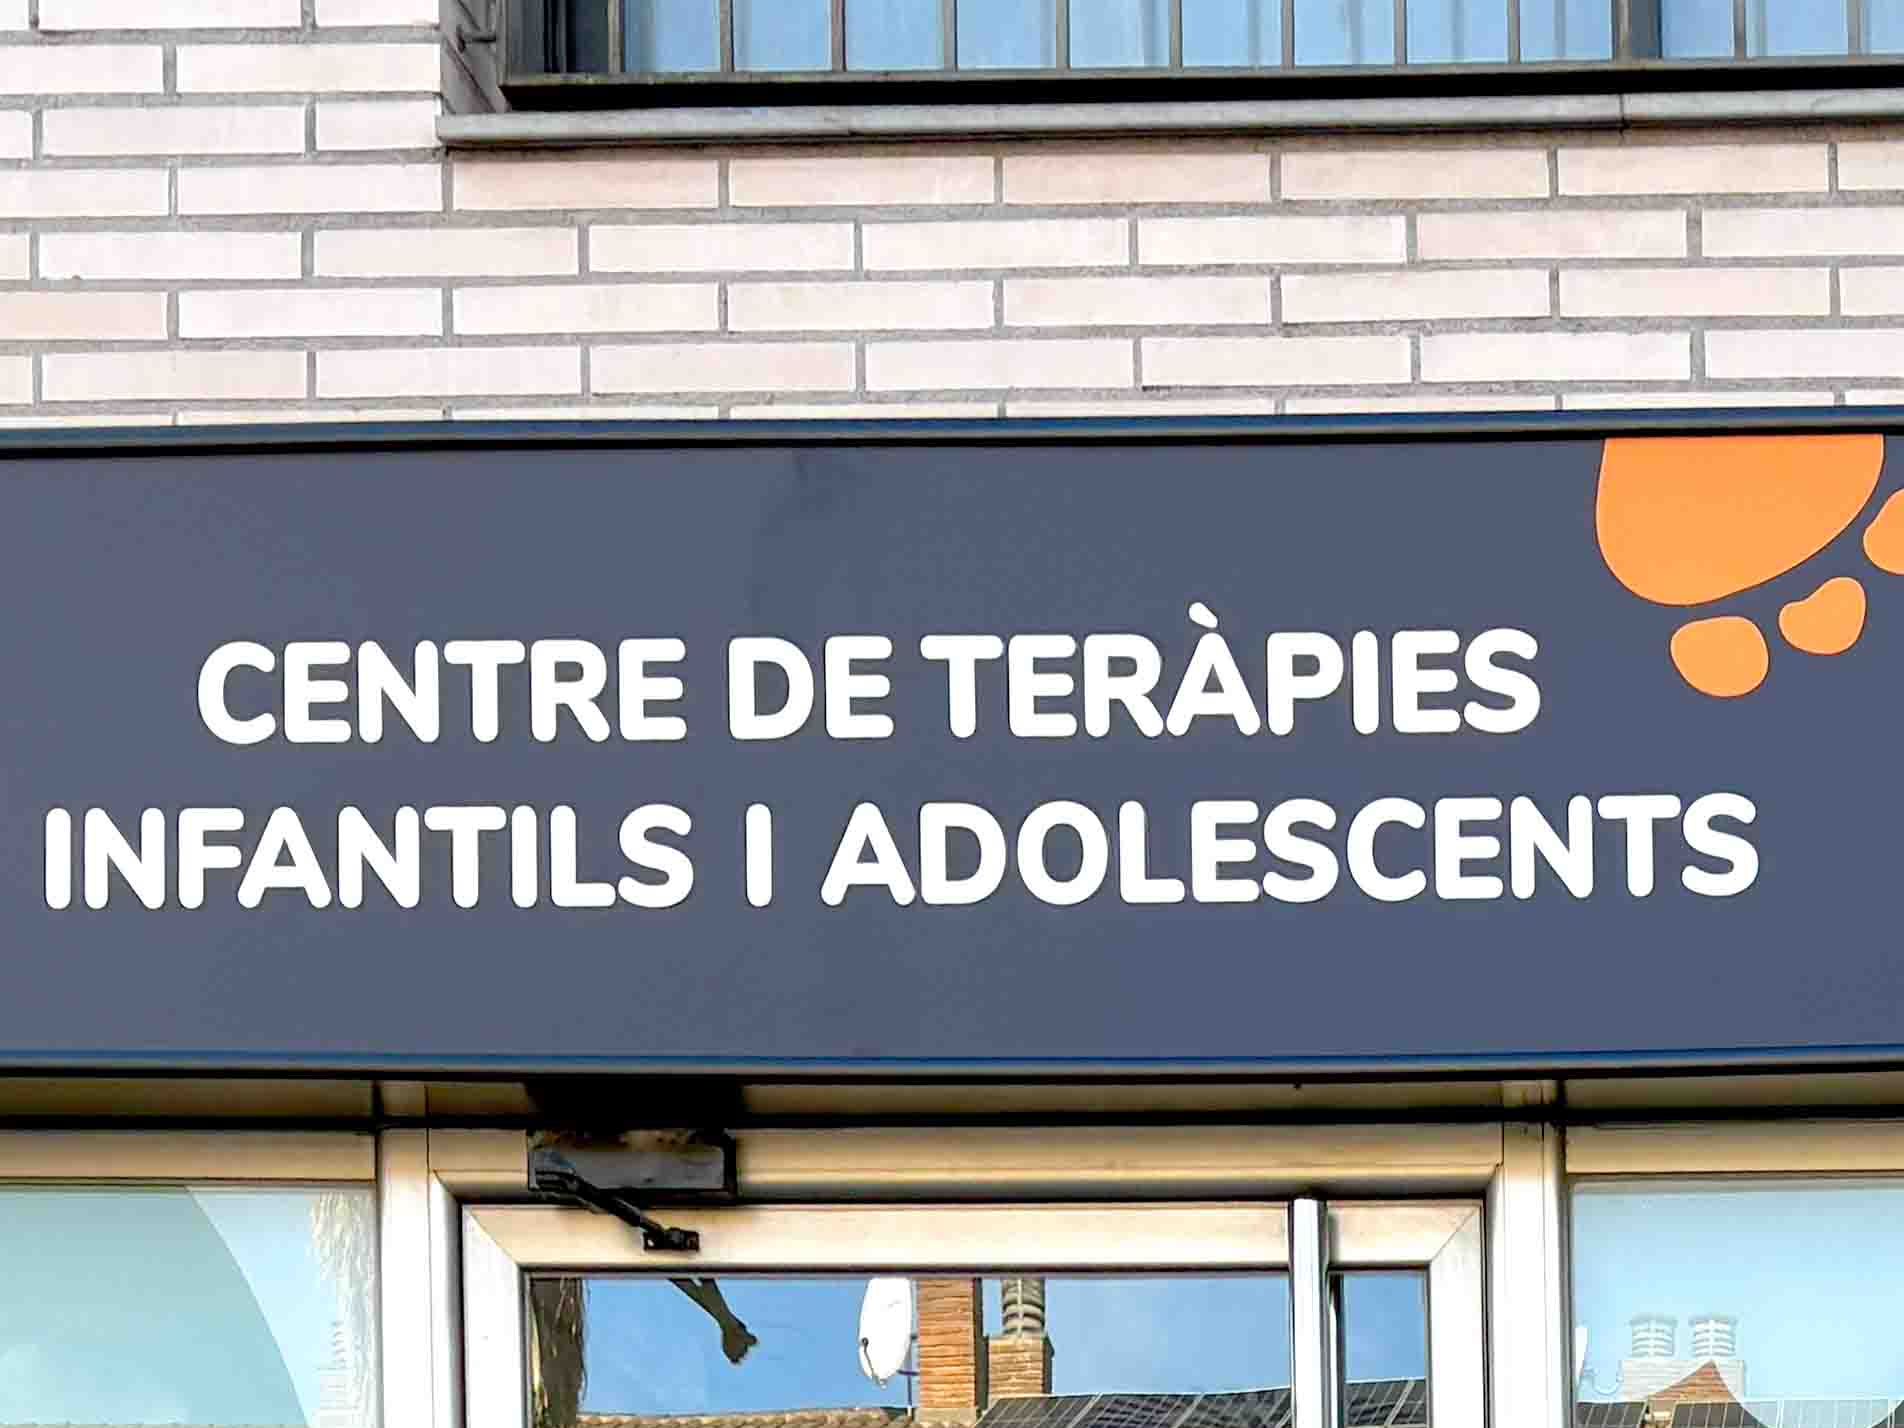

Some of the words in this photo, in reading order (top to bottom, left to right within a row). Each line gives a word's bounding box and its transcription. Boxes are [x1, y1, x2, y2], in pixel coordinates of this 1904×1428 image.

[196, 638, 688, 746] CENTRE
[726, 635, 896, 740] DE
[920, 602, 1542, 739] TERÀPIES
[42, 802, 696, 911] INFANTILS
[746, 804, 774, 907] I
[820, 791, 1761, 907] ADOLESCENTS
